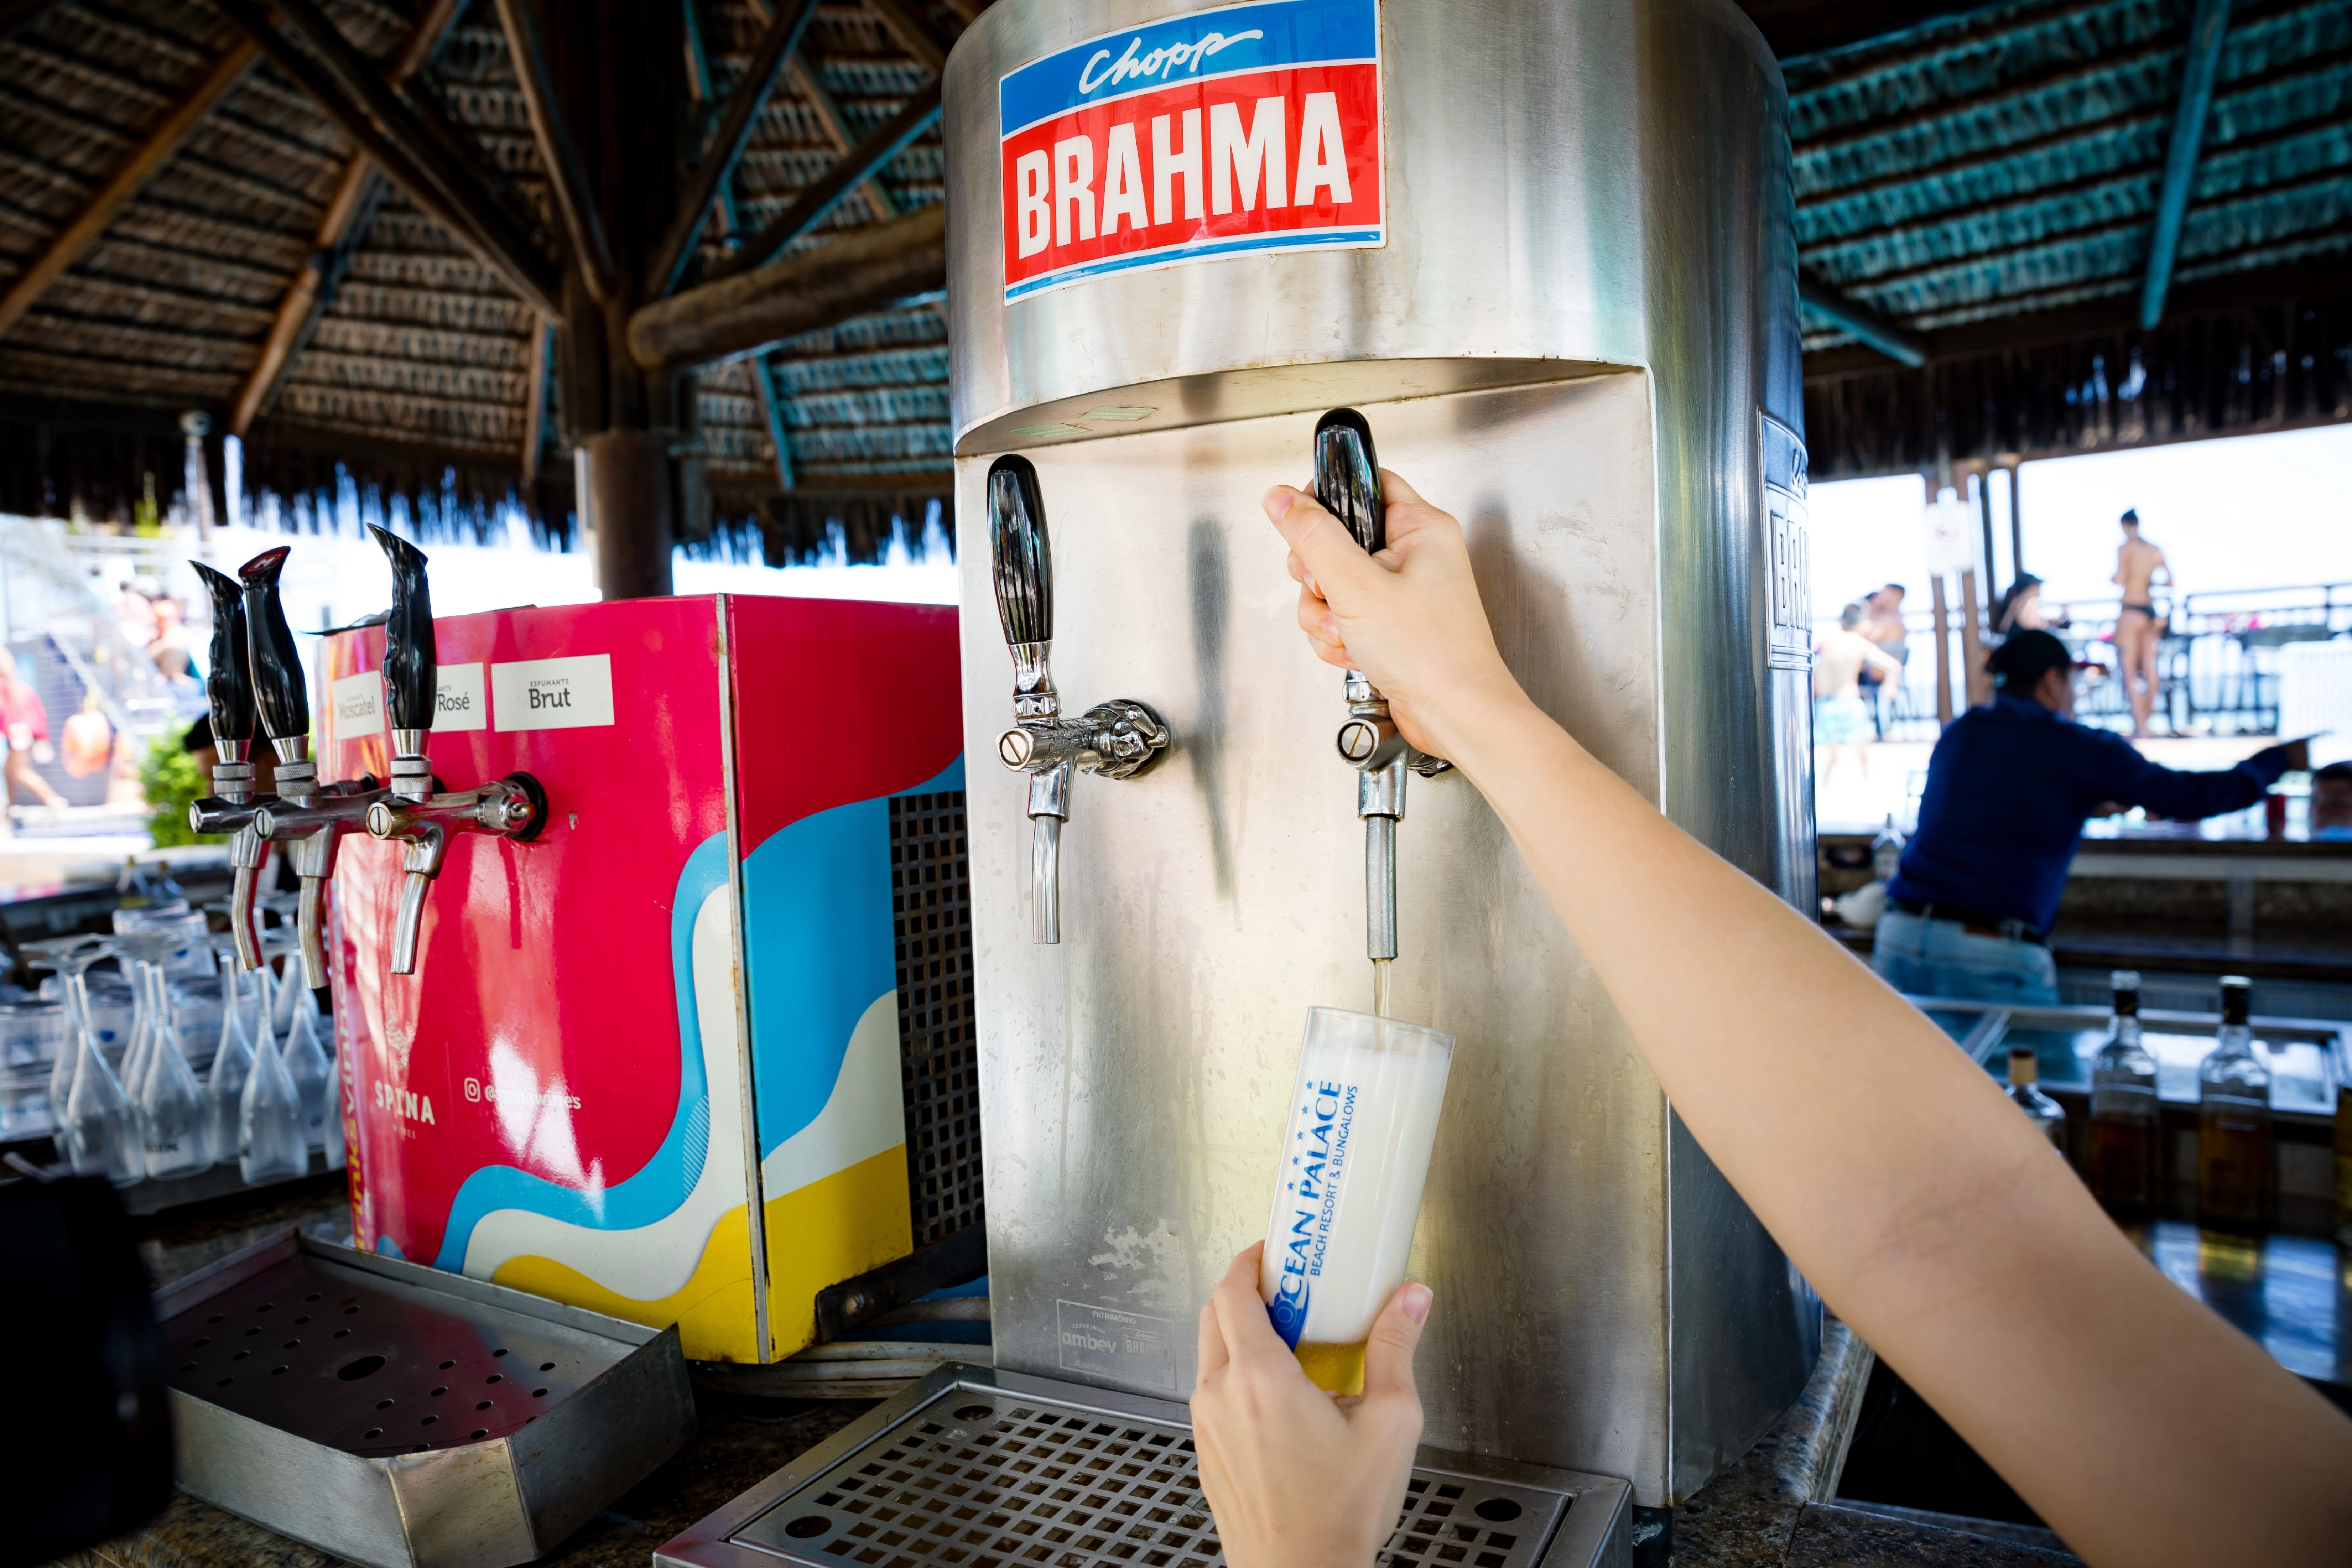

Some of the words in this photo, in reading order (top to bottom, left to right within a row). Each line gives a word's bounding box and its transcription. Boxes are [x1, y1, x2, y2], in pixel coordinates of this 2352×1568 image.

[1078, 29, 1264, 95] Chopp
[1016, 91, 1353, 259] BRAHMA
[530, 678, 569, 687] ESPUMANTE
[438, 691, 470, 712] Rosé
[529, 688, 571, 709] Brut
[375, 1079, 436, 1126] SPINA
[1299, 1080, 1342, 1200] PALACE
[1332, 1085, 1358, 1166] BUNGALOWS
[1329, 1171, 1341, 1180] &
[1319, 1182, 1337, 1232] RESORT
[1310, 1235, 1327, 1276] BEACH
[1072, 1323, 1106, 1335] CERVEJARIA
[1092, 1311, 1136, 1324] PATRIMÔNIO
[1062, 1332, 1117, 1354] ambev
